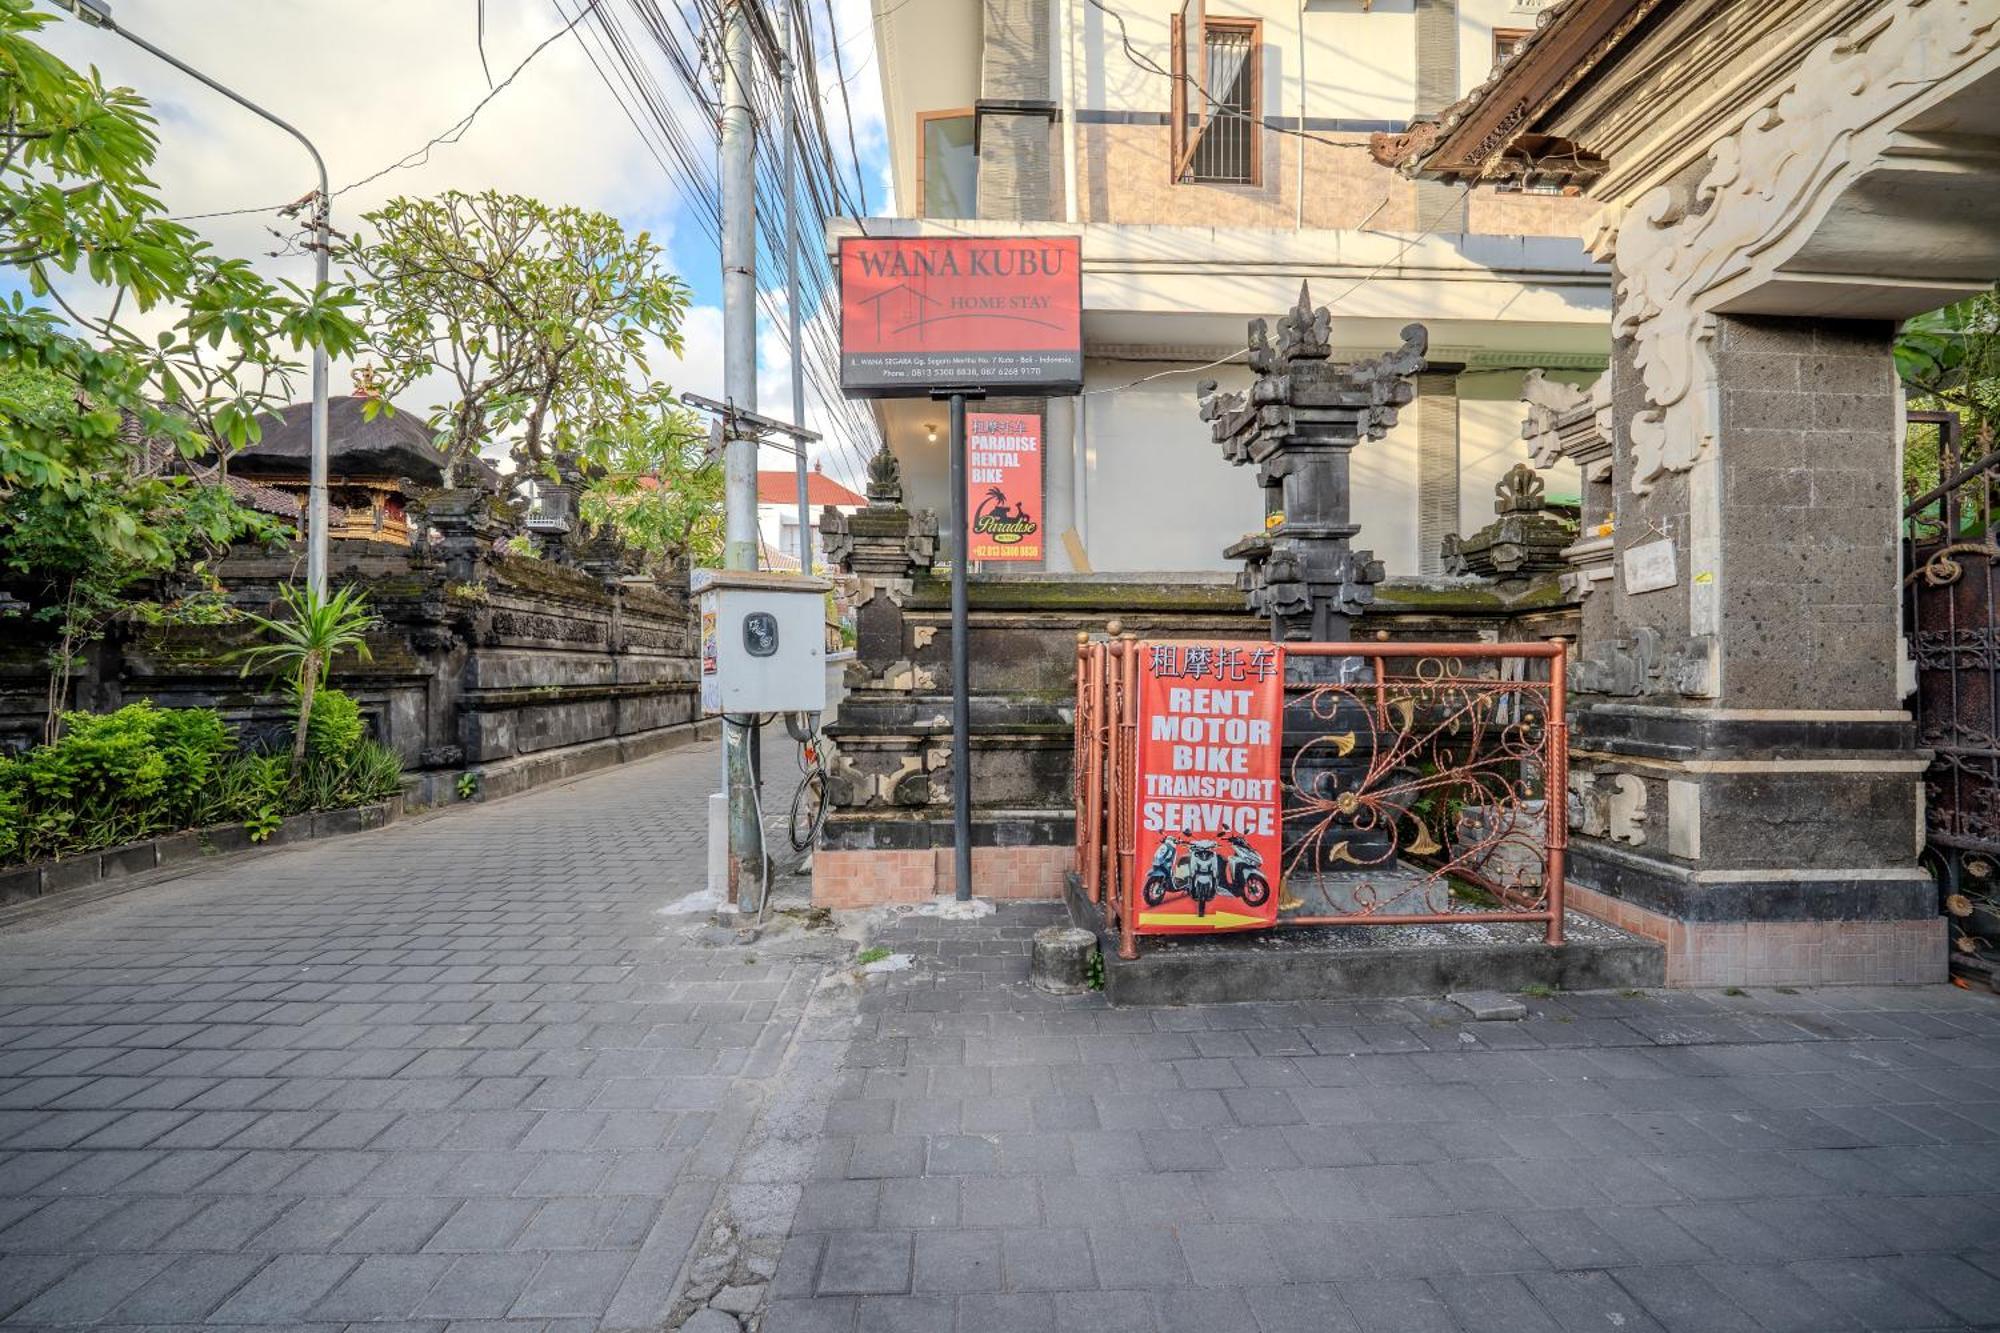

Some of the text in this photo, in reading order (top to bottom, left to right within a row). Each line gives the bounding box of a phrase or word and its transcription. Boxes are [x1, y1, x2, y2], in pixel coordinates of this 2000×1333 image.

[858, 248, 1064, 278] WANA KUBU
[951, 295, 1052, 309] HOME STAY
[885, 357, 913, 366] SEGARA
[1020, 367, 1041, 376] 9170
[971, 435, 1037, 452] PARADISE
[971, 451, 1020, 468] RENTAL
[972, 468, 1003, 484] BIKE
[974, 515, 1037, 533] Paradise
[1149, 644, 1278, 682] 租摩托车
[1169, 687, 1255, 715] RENT
[1151, 715, 1272, 745] MOTOR
[1172, 745, 1249, 773] BIKE
[1144, 773, 1276, 801] TRANSPORT
[1143, 802, 1275, 836] SERVICE
